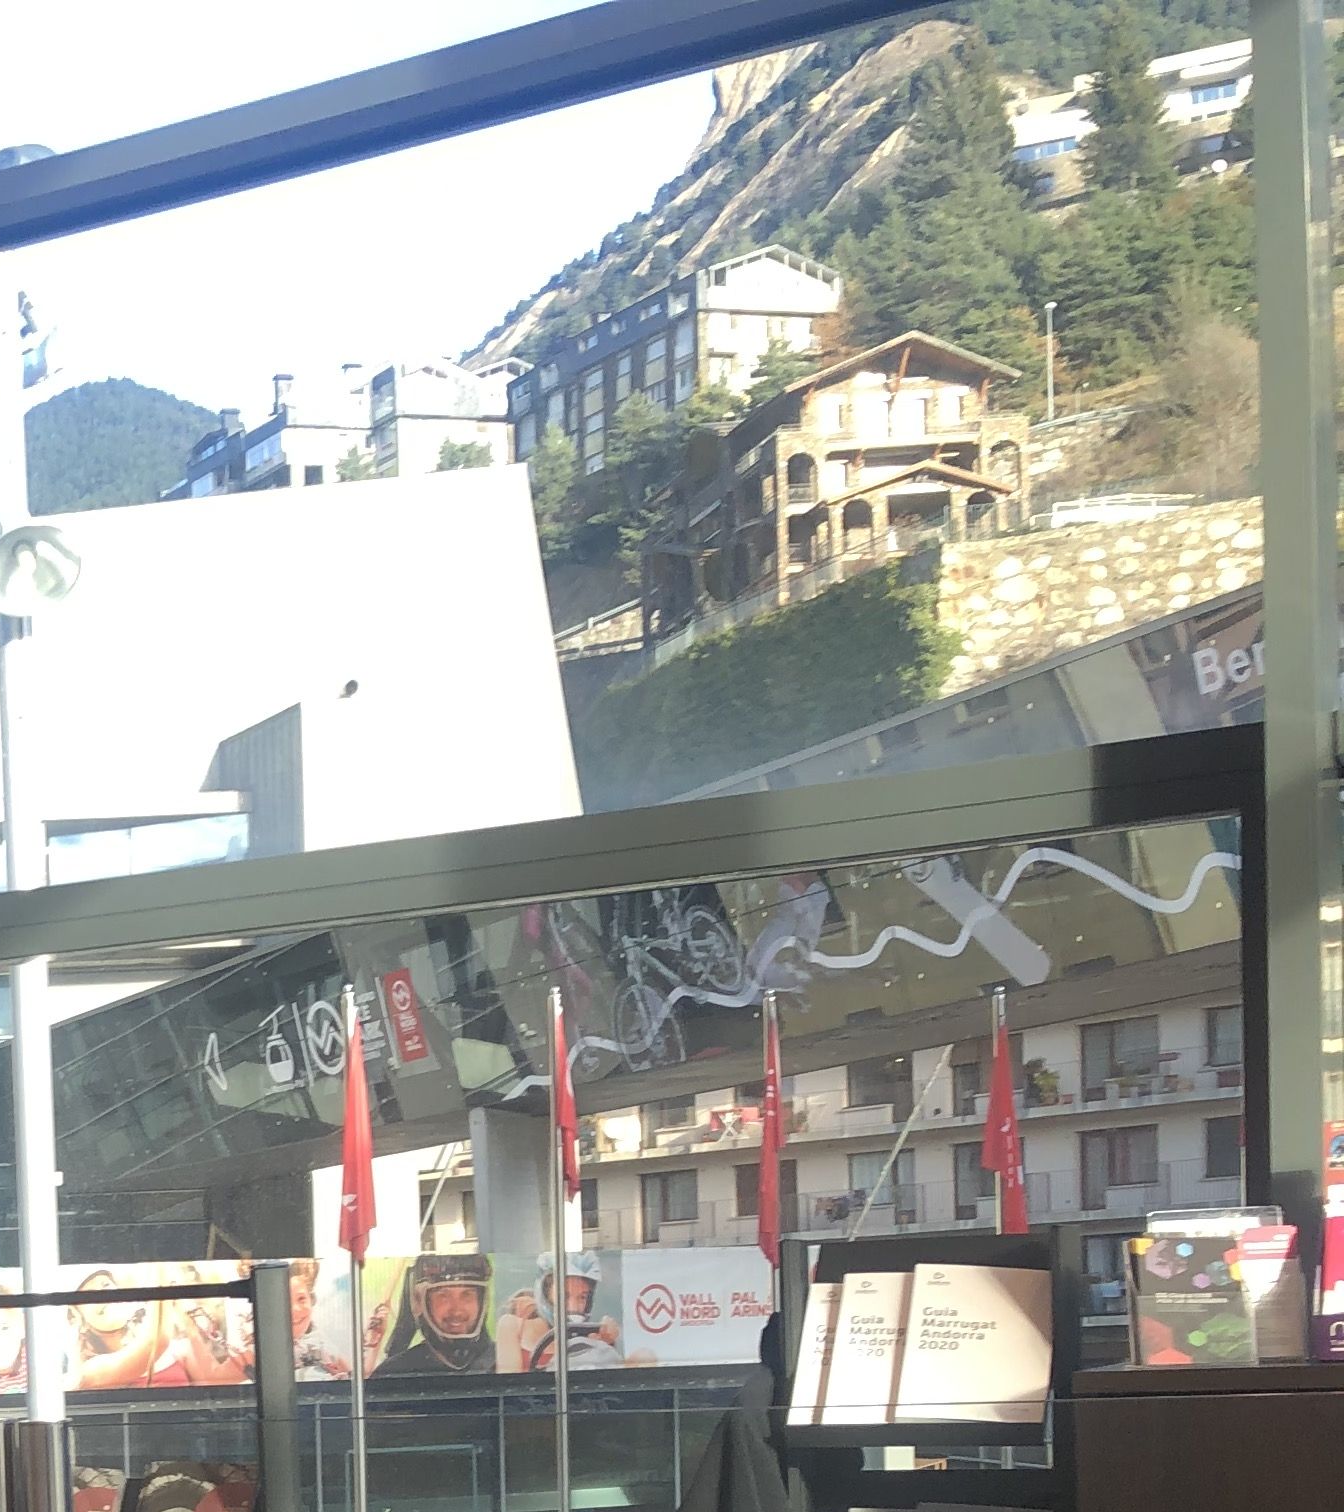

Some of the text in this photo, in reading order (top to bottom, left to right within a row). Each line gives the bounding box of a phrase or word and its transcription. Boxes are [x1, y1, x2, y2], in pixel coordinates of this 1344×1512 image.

[679, 1292, 758, 1305] VALL PAL
[680, 1306, 720, 1319] NORD
[923, 1306, 958, 1317] Guia
[850, 1315, 885, 1325] Guia
[921, 1318, 997, 1331] Marrugat
[920, 1329, 986, 1341] Andorra
[919, 1340, 960, 1350] 2020
